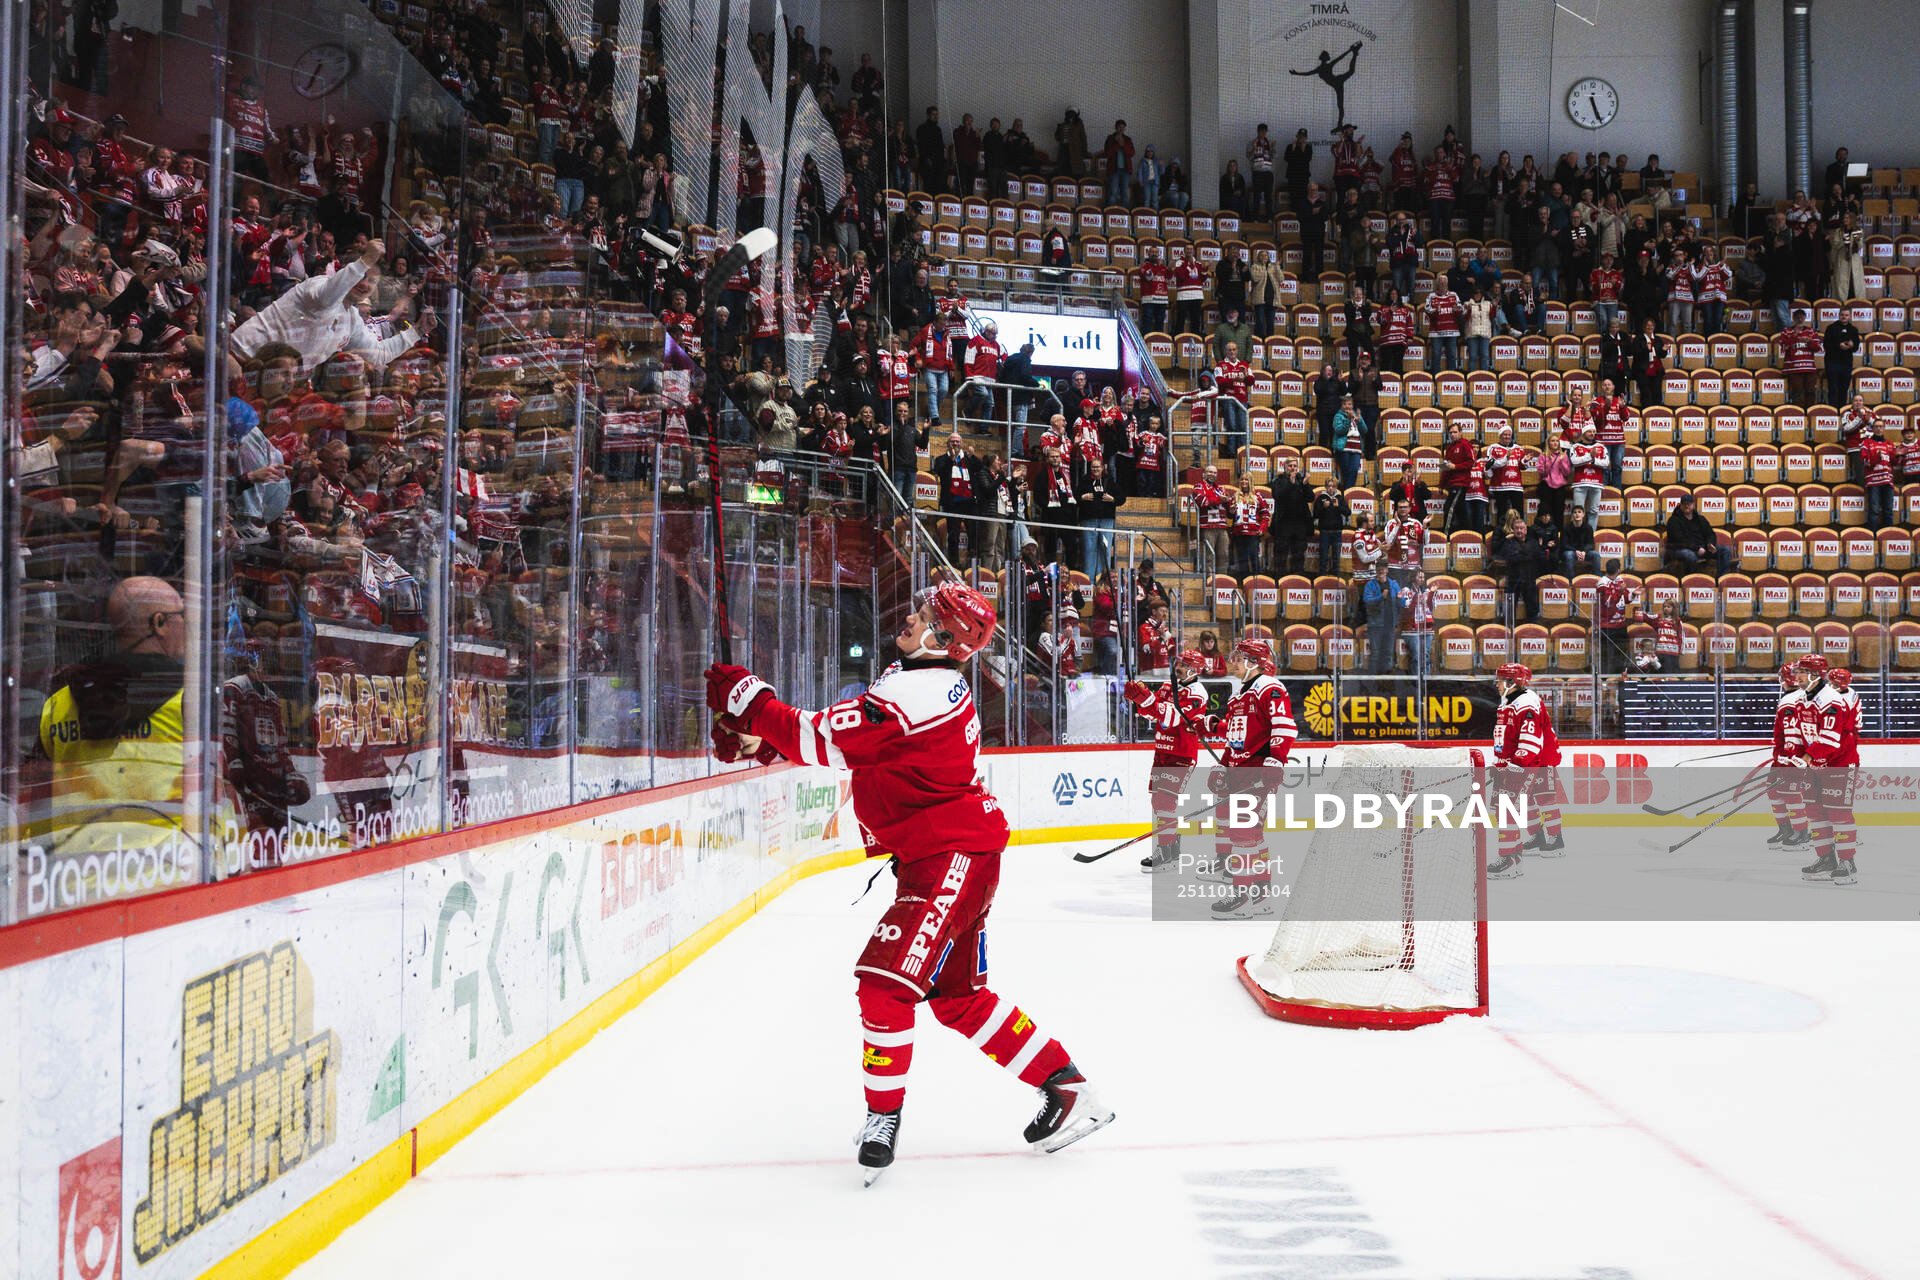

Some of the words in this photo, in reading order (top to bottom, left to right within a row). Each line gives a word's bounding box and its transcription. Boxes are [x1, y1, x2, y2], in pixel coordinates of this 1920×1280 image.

[1310, 1, 1350, 14] TIMRÅ
[1283, 18, 1378, 42] KONSTÅKNINGSKLUBB
[1636, 545, 1658, 553] MAXI
[1780, 544, 1802, 552] MAXI
[1816, 544, 1838, 552] MAXI
[1288, 592, 1310, 600] MAXI
[1472, 592, 1494, 600] MAXI
[1690, 591, 1713, 599] MAXI
[1728, 591, 1751, 599] MAXI
[1838, 590, 1861, 598] MAXI
[1875, 590, 1897, 598] MAXI
[1522, 642, 1545, 650] MAXI
[1561, 642, 1584, 650] MAXI
[1749, 641, 1772, 649] MAXI
[1825, 640, 1848, 648] MAXI
[1520, 720, 1535, 734] 26
[1823, 716, 1836, 730] 10
[1444, 727, 1459, 736] ab
[1082, 777, 1124, 798] SCA
[796, 781, 837, 817] Byberg
[1872, 792, 1898, 801] Entr.
[1901, 791, 1917, 801] AB
[225, 805, 341, 874] Brandcode
[28, 826, 194, 915] Brandcode
[600, 817, 686, 922] BORGA
[903, 858, 970, 970] PEAB
[182, 942, 297, 1106] EURO
[133, 1033, 333, 1266] JACKPOT
